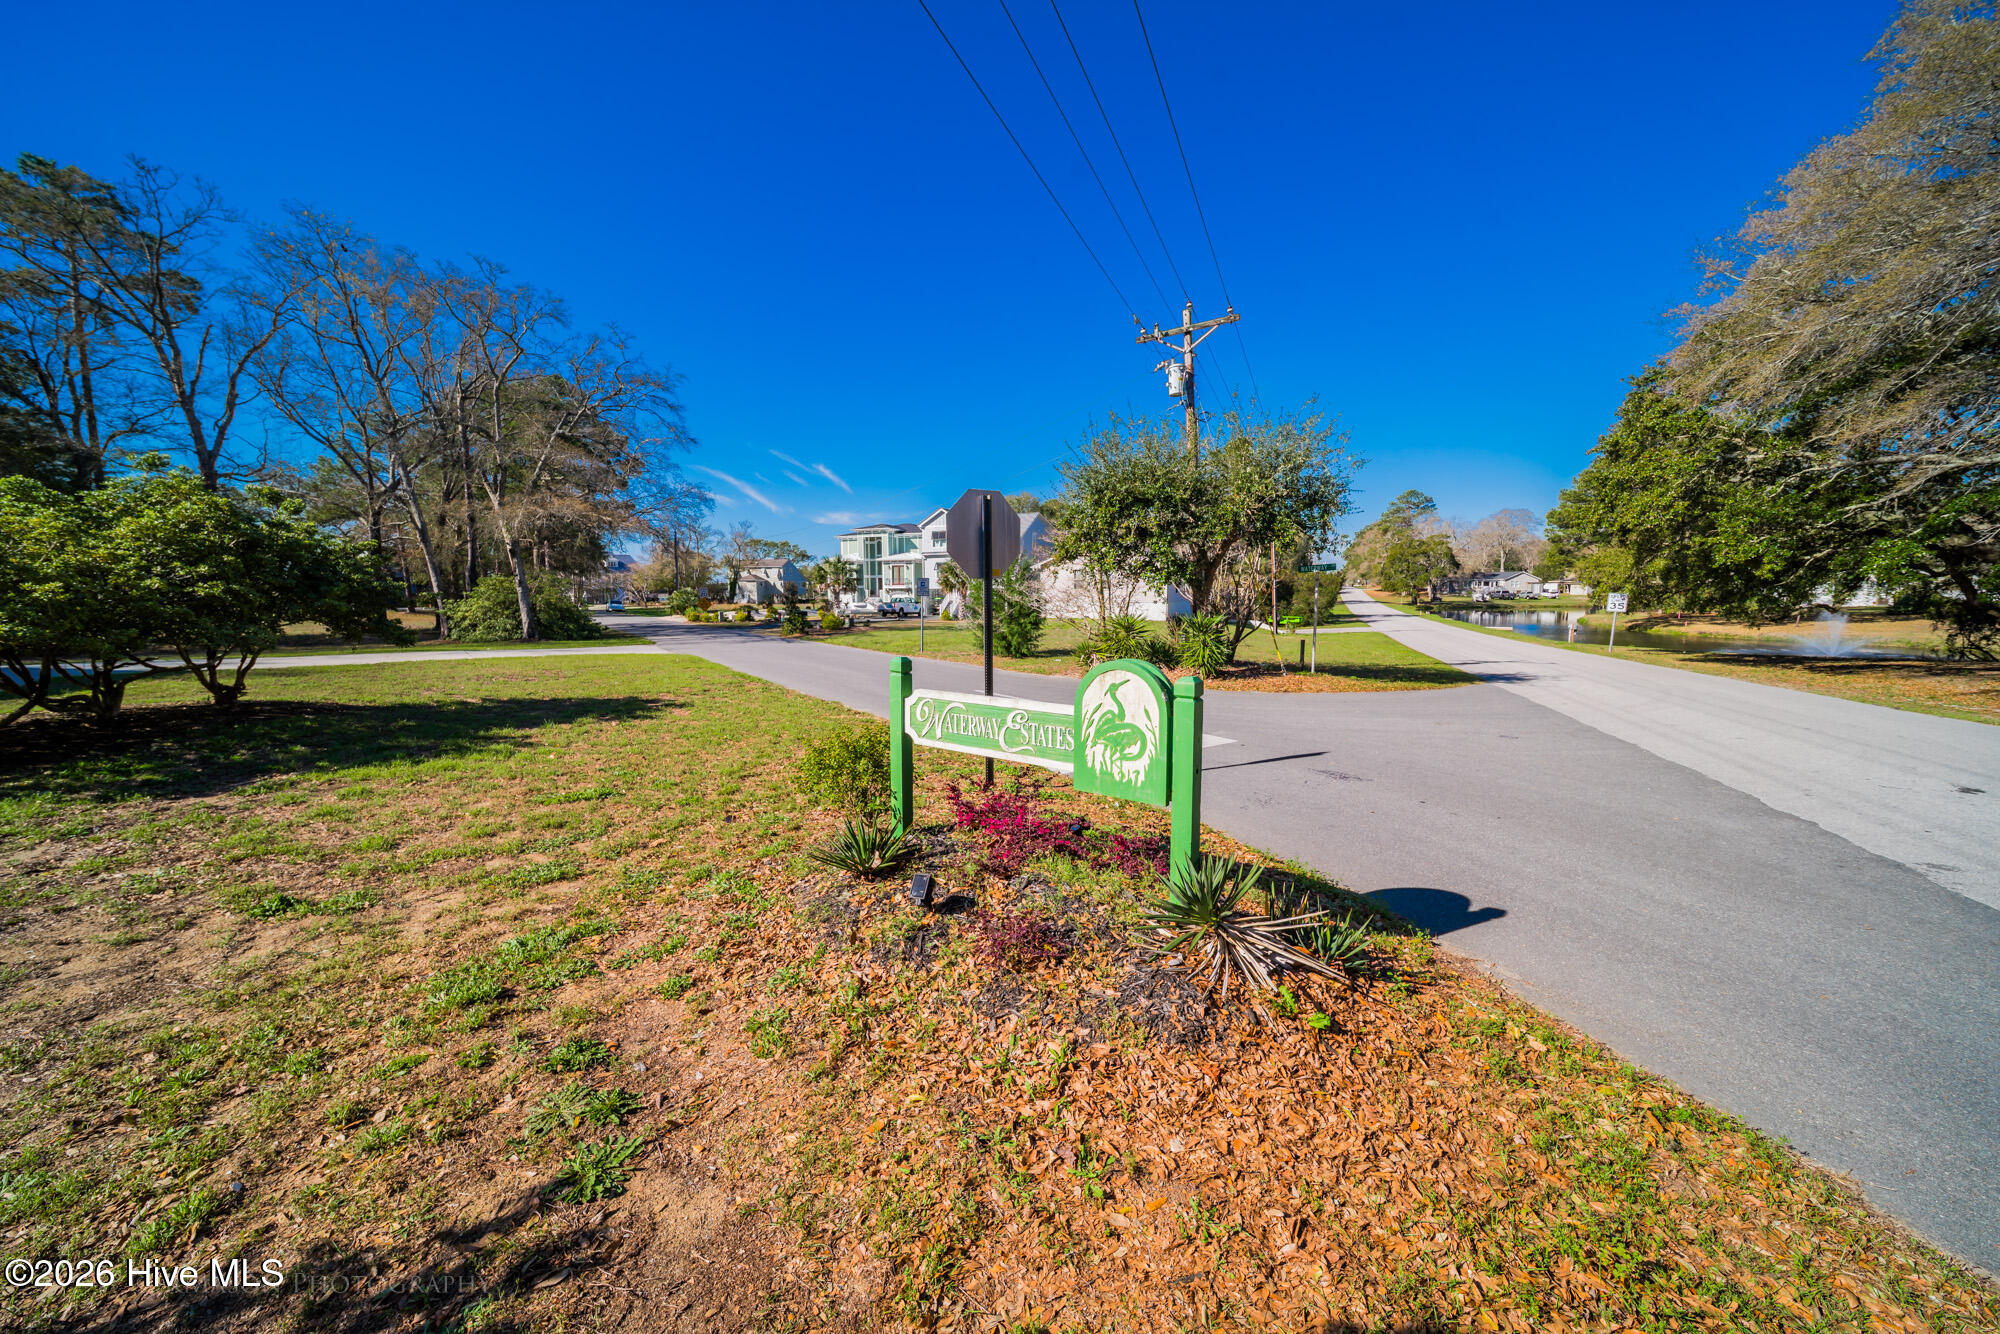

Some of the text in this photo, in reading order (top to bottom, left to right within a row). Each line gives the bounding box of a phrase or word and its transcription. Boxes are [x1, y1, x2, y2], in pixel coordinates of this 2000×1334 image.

[1609, 602, 1625, 610] 35
[916, 698, 1075, 753] WATERWAY ESTATES
